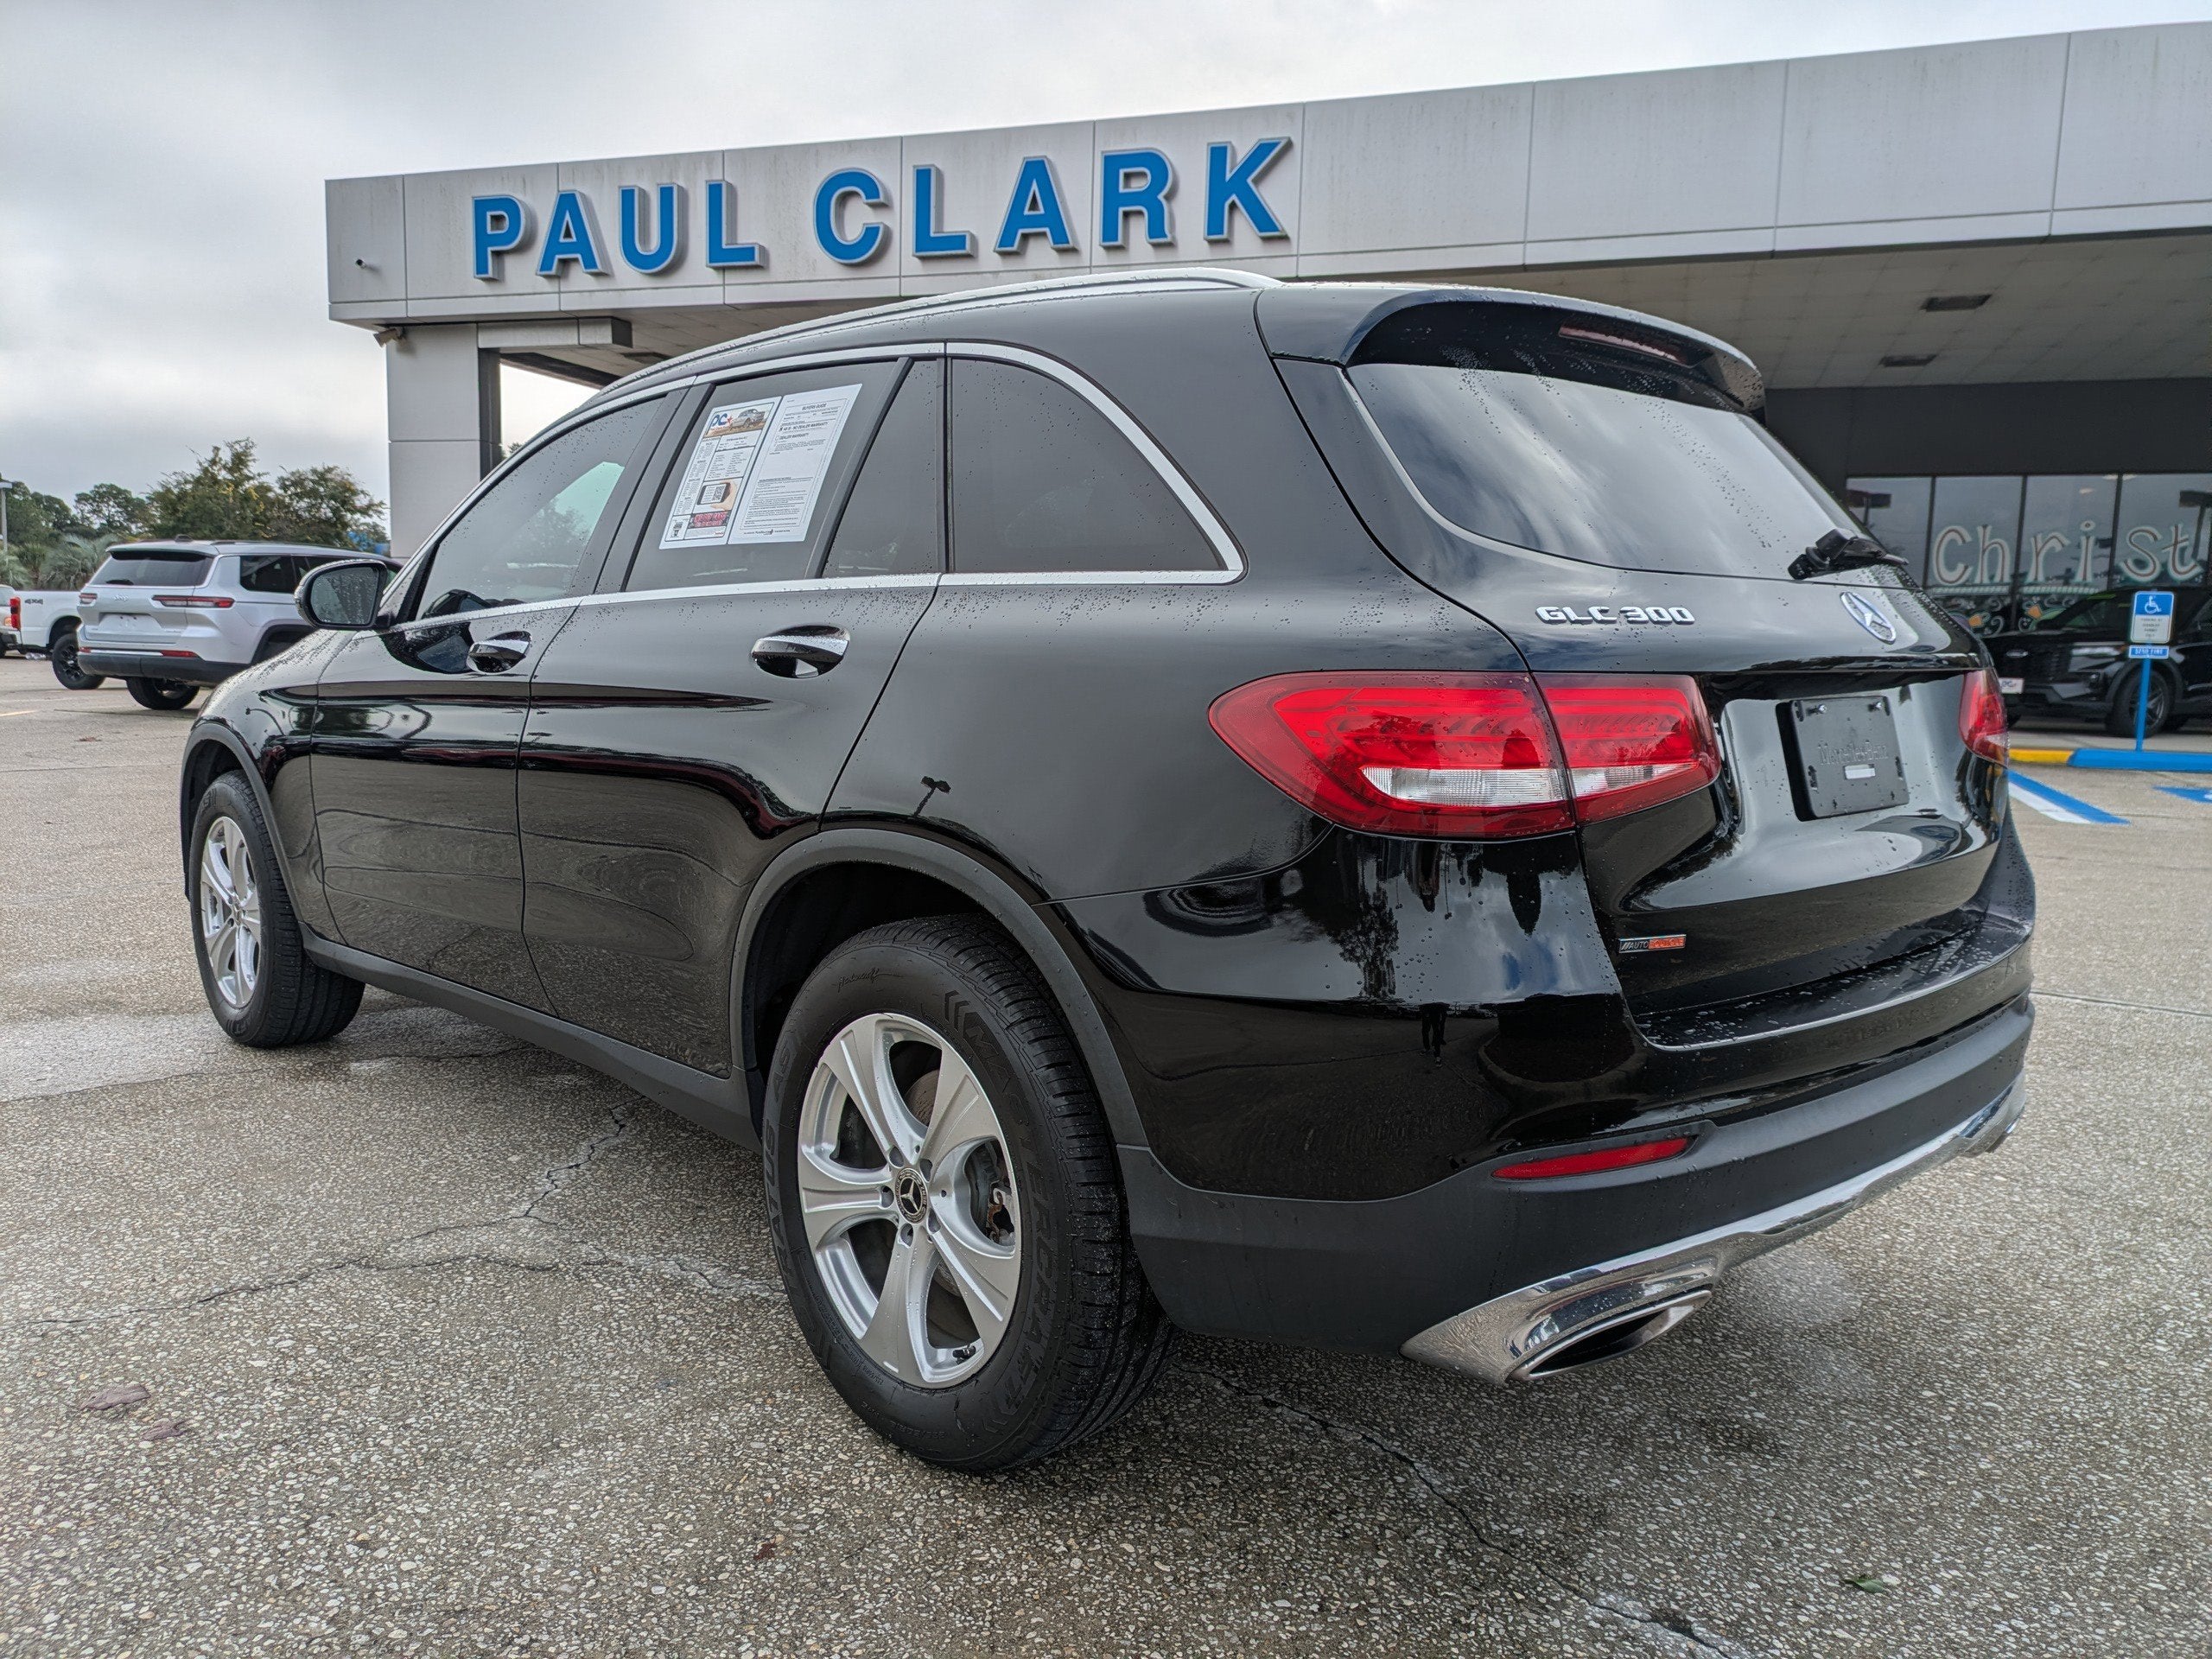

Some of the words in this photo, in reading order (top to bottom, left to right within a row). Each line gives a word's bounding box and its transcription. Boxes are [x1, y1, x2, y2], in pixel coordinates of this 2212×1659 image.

[472, 179, 764, 281] PAUL
[814, 137, 1292, 265] CLARK
[1535, 606, 1618, 625] GLC
[1618, 606, 1695, 626] 300
